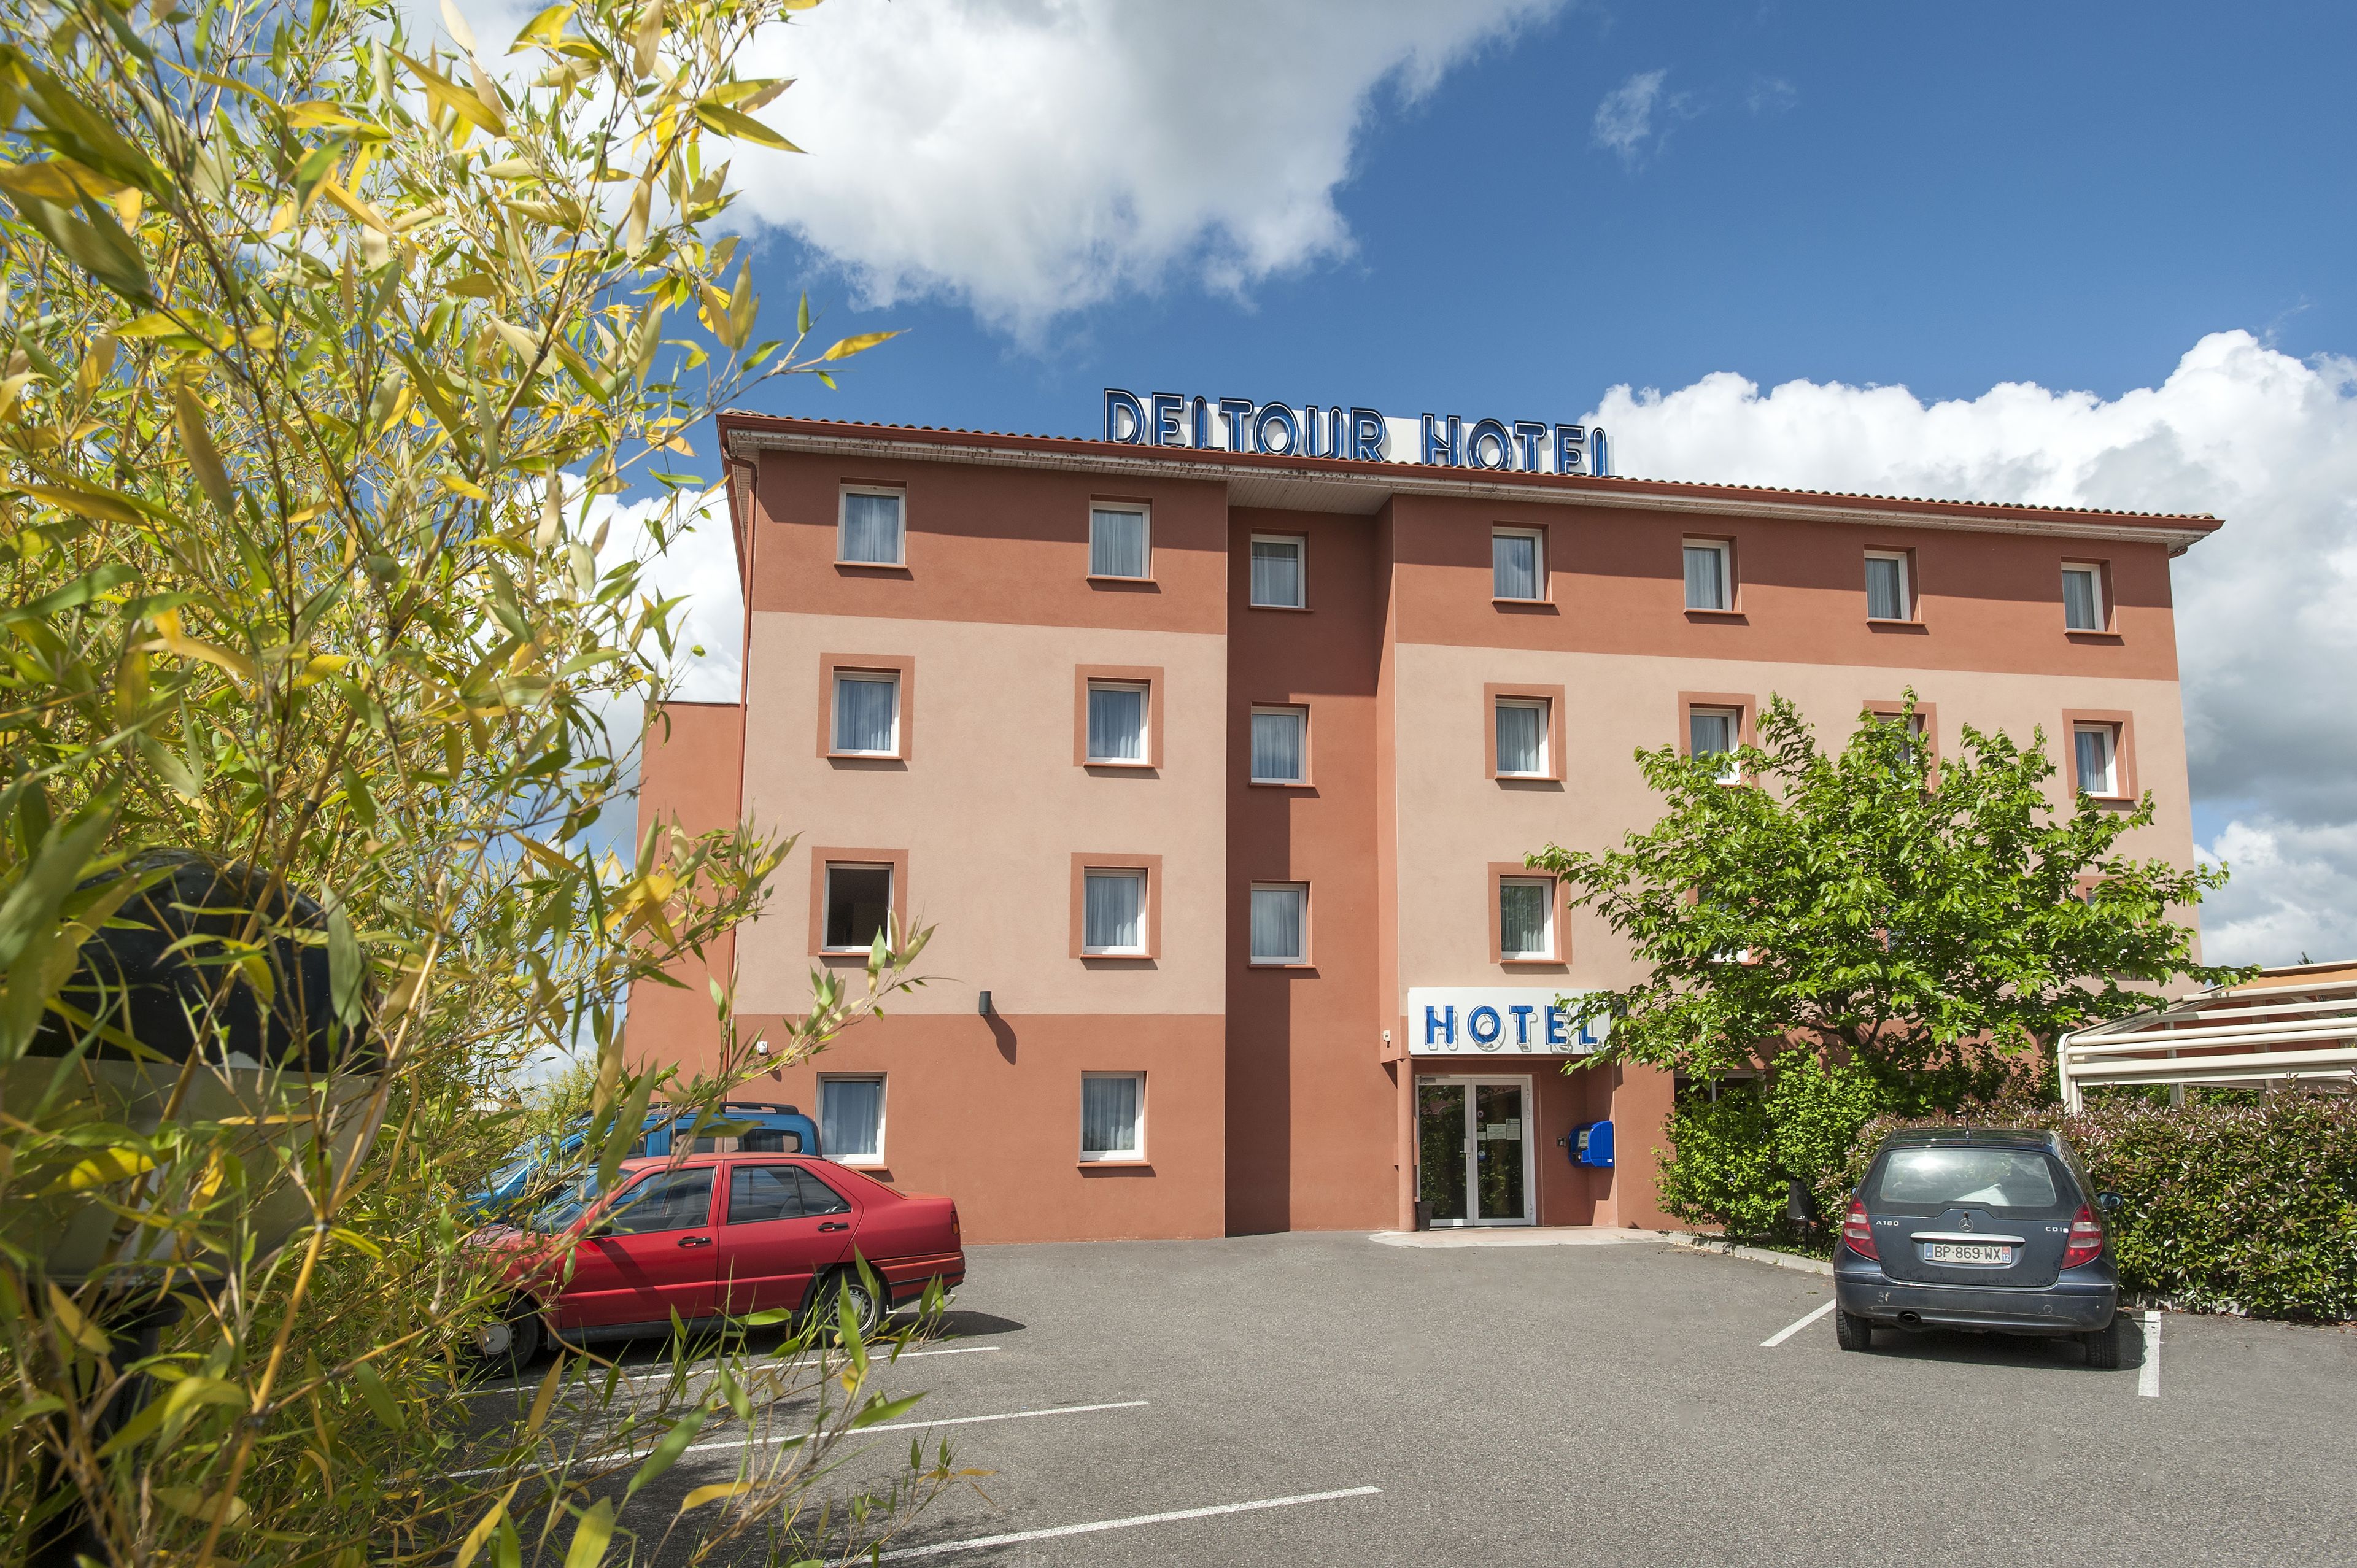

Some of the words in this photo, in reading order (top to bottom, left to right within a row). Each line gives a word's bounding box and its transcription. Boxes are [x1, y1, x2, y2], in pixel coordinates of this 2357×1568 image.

[1421, 412, 1624, 477] HOTEL
[1424, 1004, 1600, 1045] HOTEL
[1934, 1245, 2001, 1261] BP-869-WX
